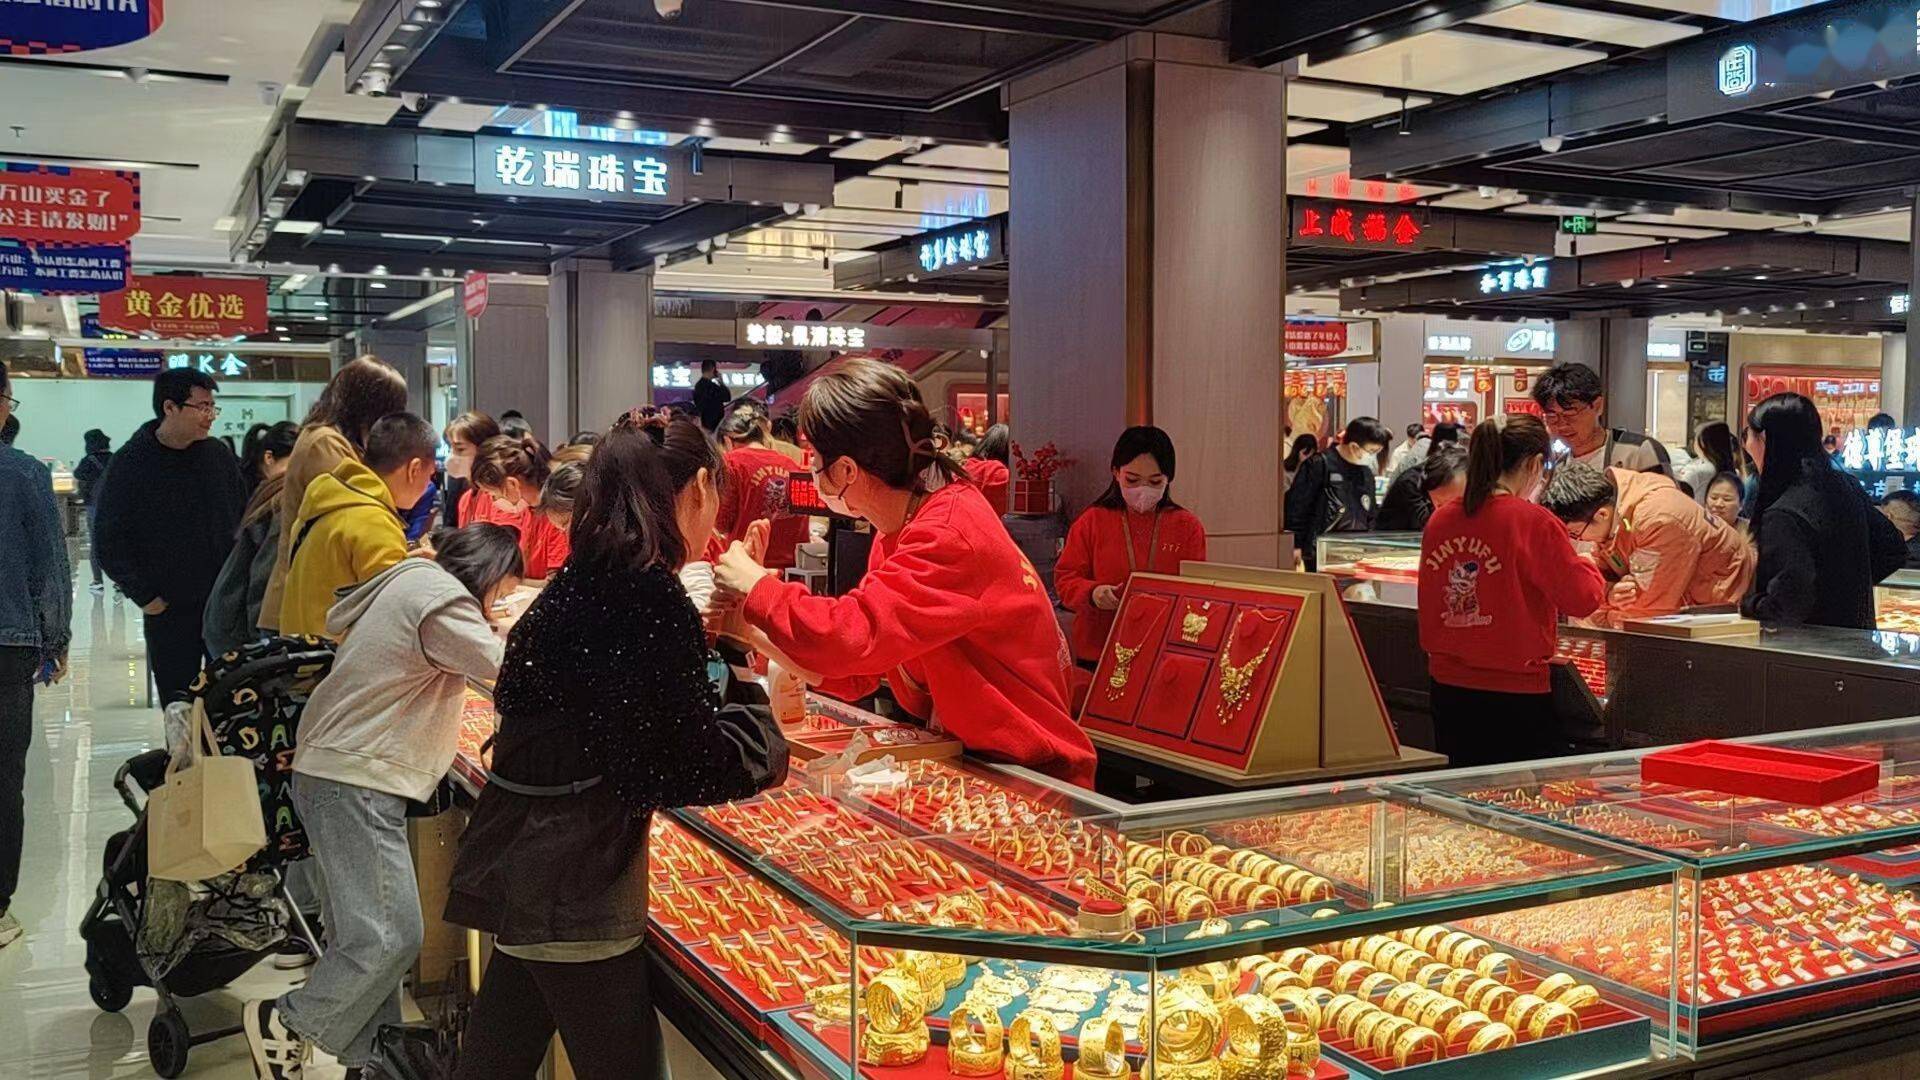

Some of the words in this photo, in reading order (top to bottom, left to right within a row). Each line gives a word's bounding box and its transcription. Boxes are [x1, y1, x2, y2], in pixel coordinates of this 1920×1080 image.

[495, 145, 668, 196] 乾瑞珠宝
[125, 289, 244, 320] 黄金优选
[1425, 535, 1503, 575] JINYUFU
